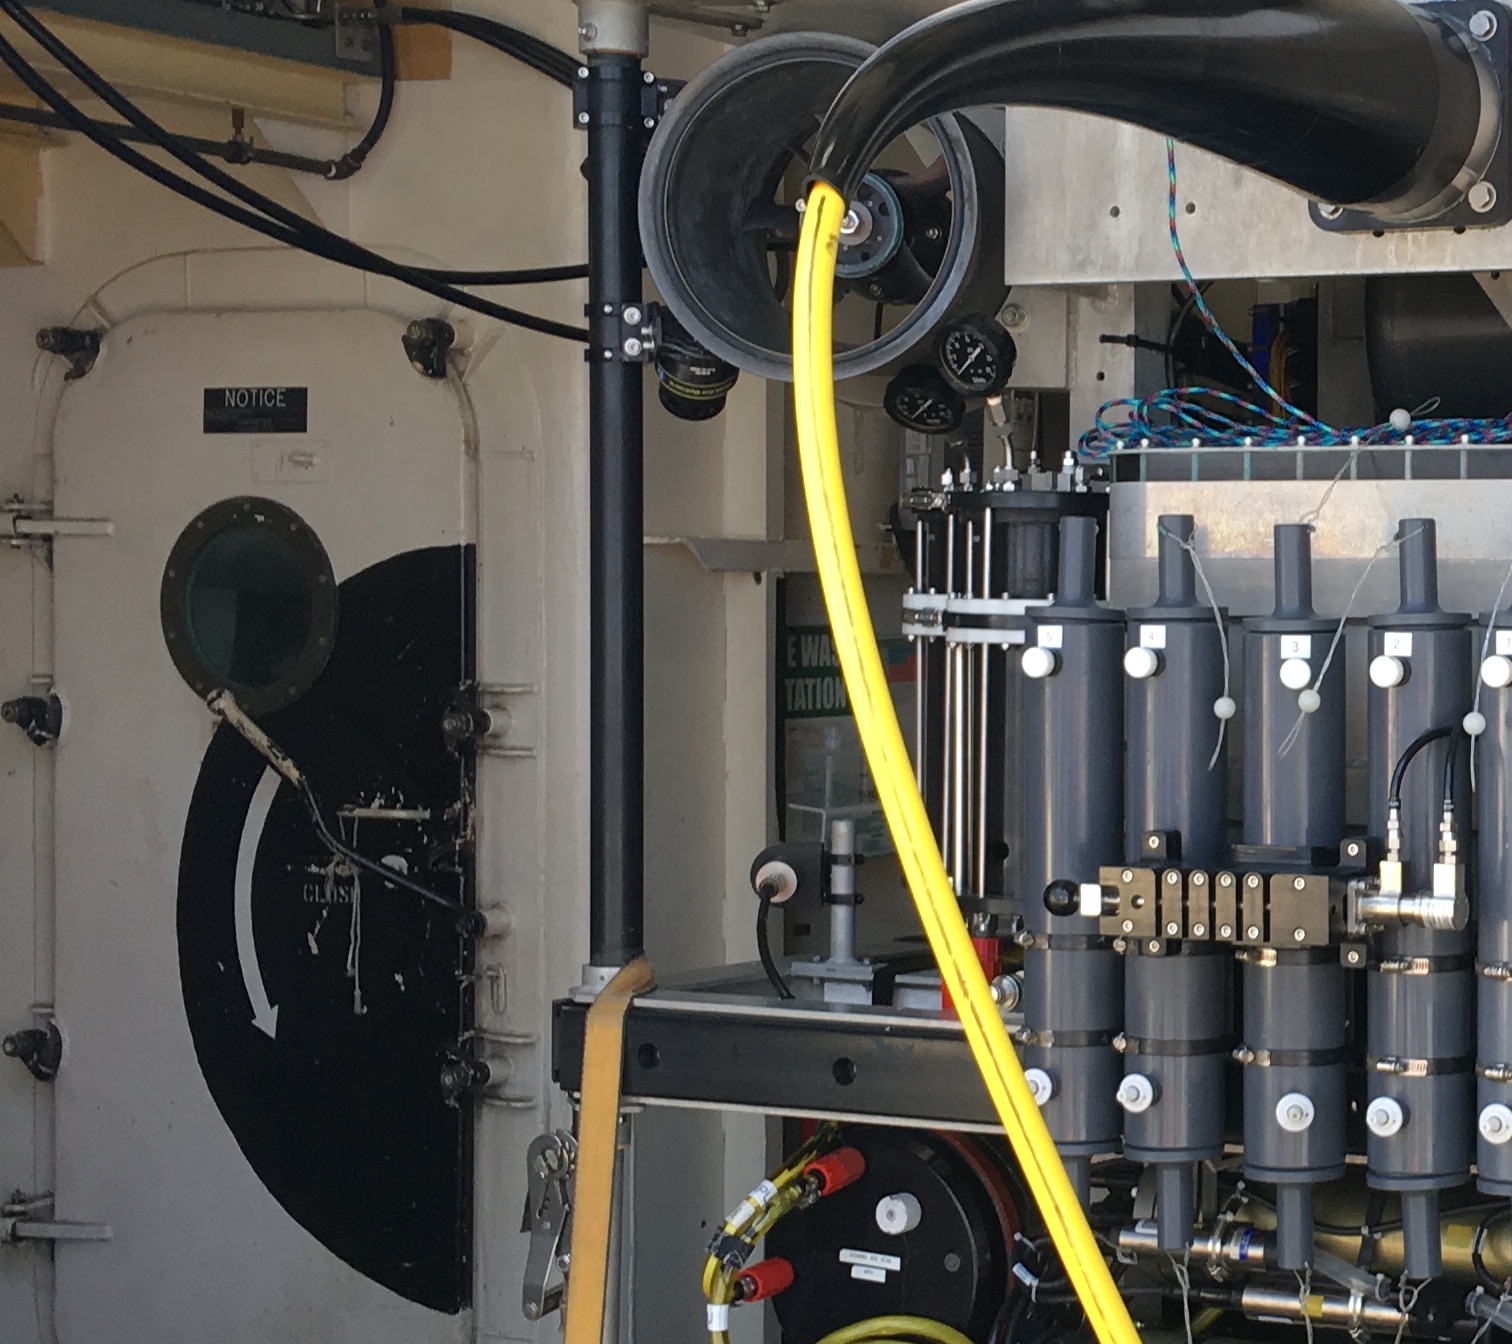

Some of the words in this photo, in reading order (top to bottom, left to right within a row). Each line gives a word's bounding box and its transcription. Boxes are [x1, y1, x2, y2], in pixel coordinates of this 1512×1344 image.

[224, 388, 287, 408] NOTICE
[1291, 640, 1300, 653] 3
[1393, 638, 1400, 650] 2
